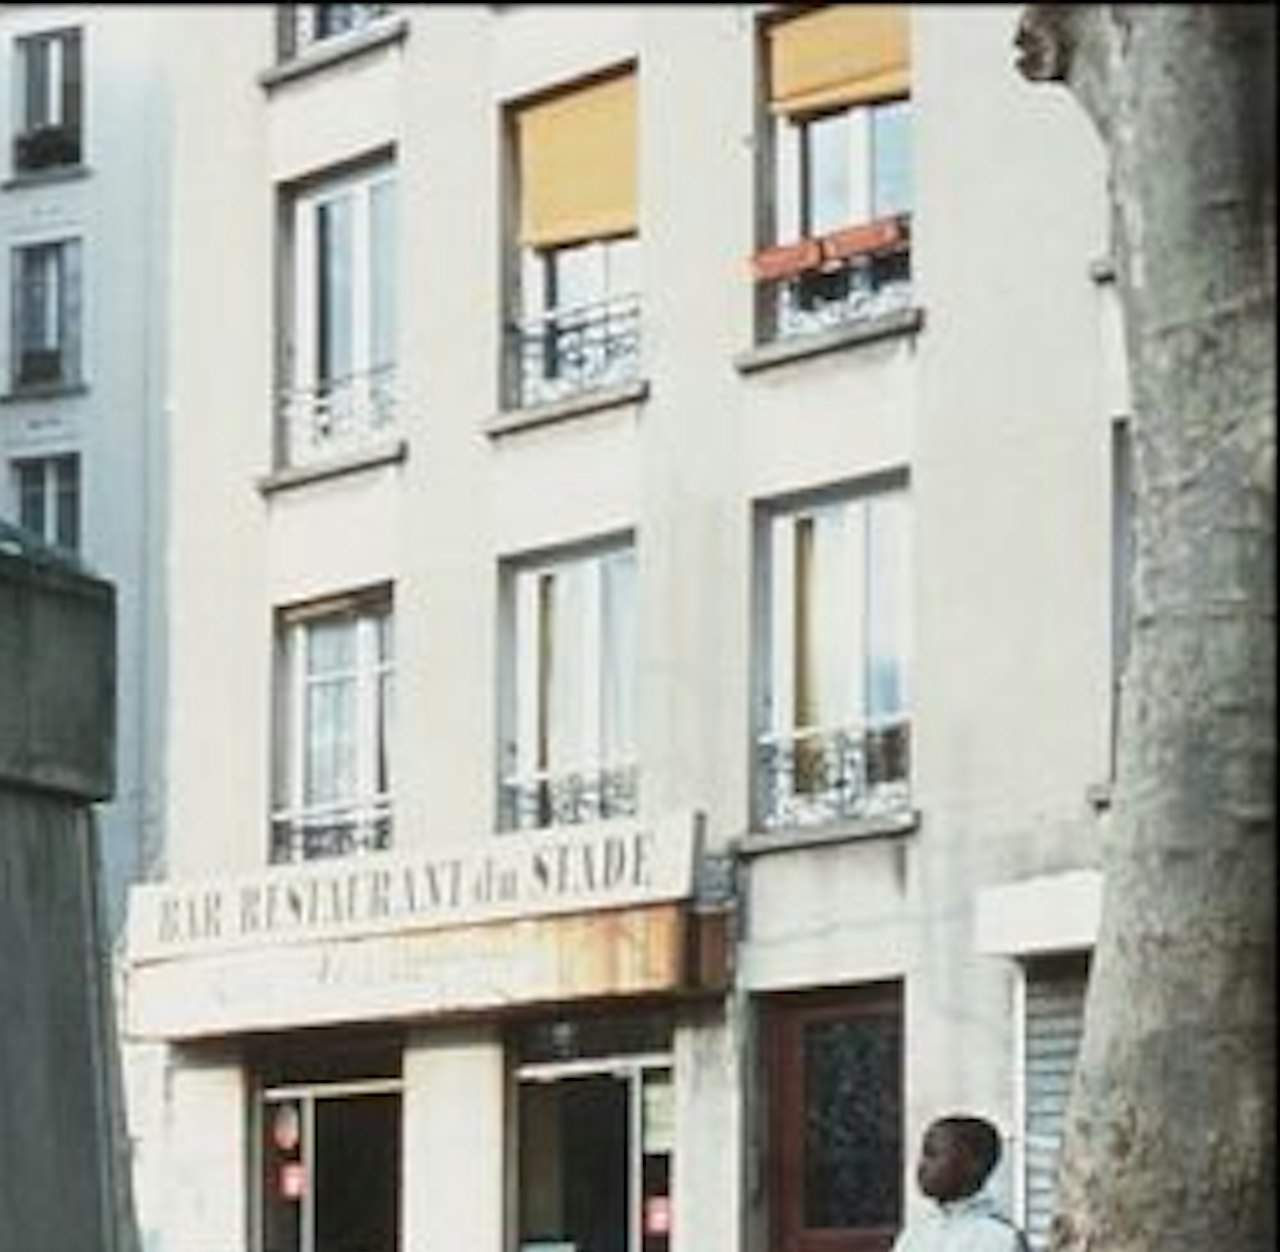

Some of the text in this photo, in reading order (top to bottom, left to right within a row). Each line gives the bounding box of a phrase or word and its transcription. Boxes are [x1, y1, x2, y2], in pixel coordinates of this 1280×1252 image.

[158, 892, 222, 943] BAR
[239, 860, 463, 937] RESTAURANT
[531, 833, 654, 894] STADE
